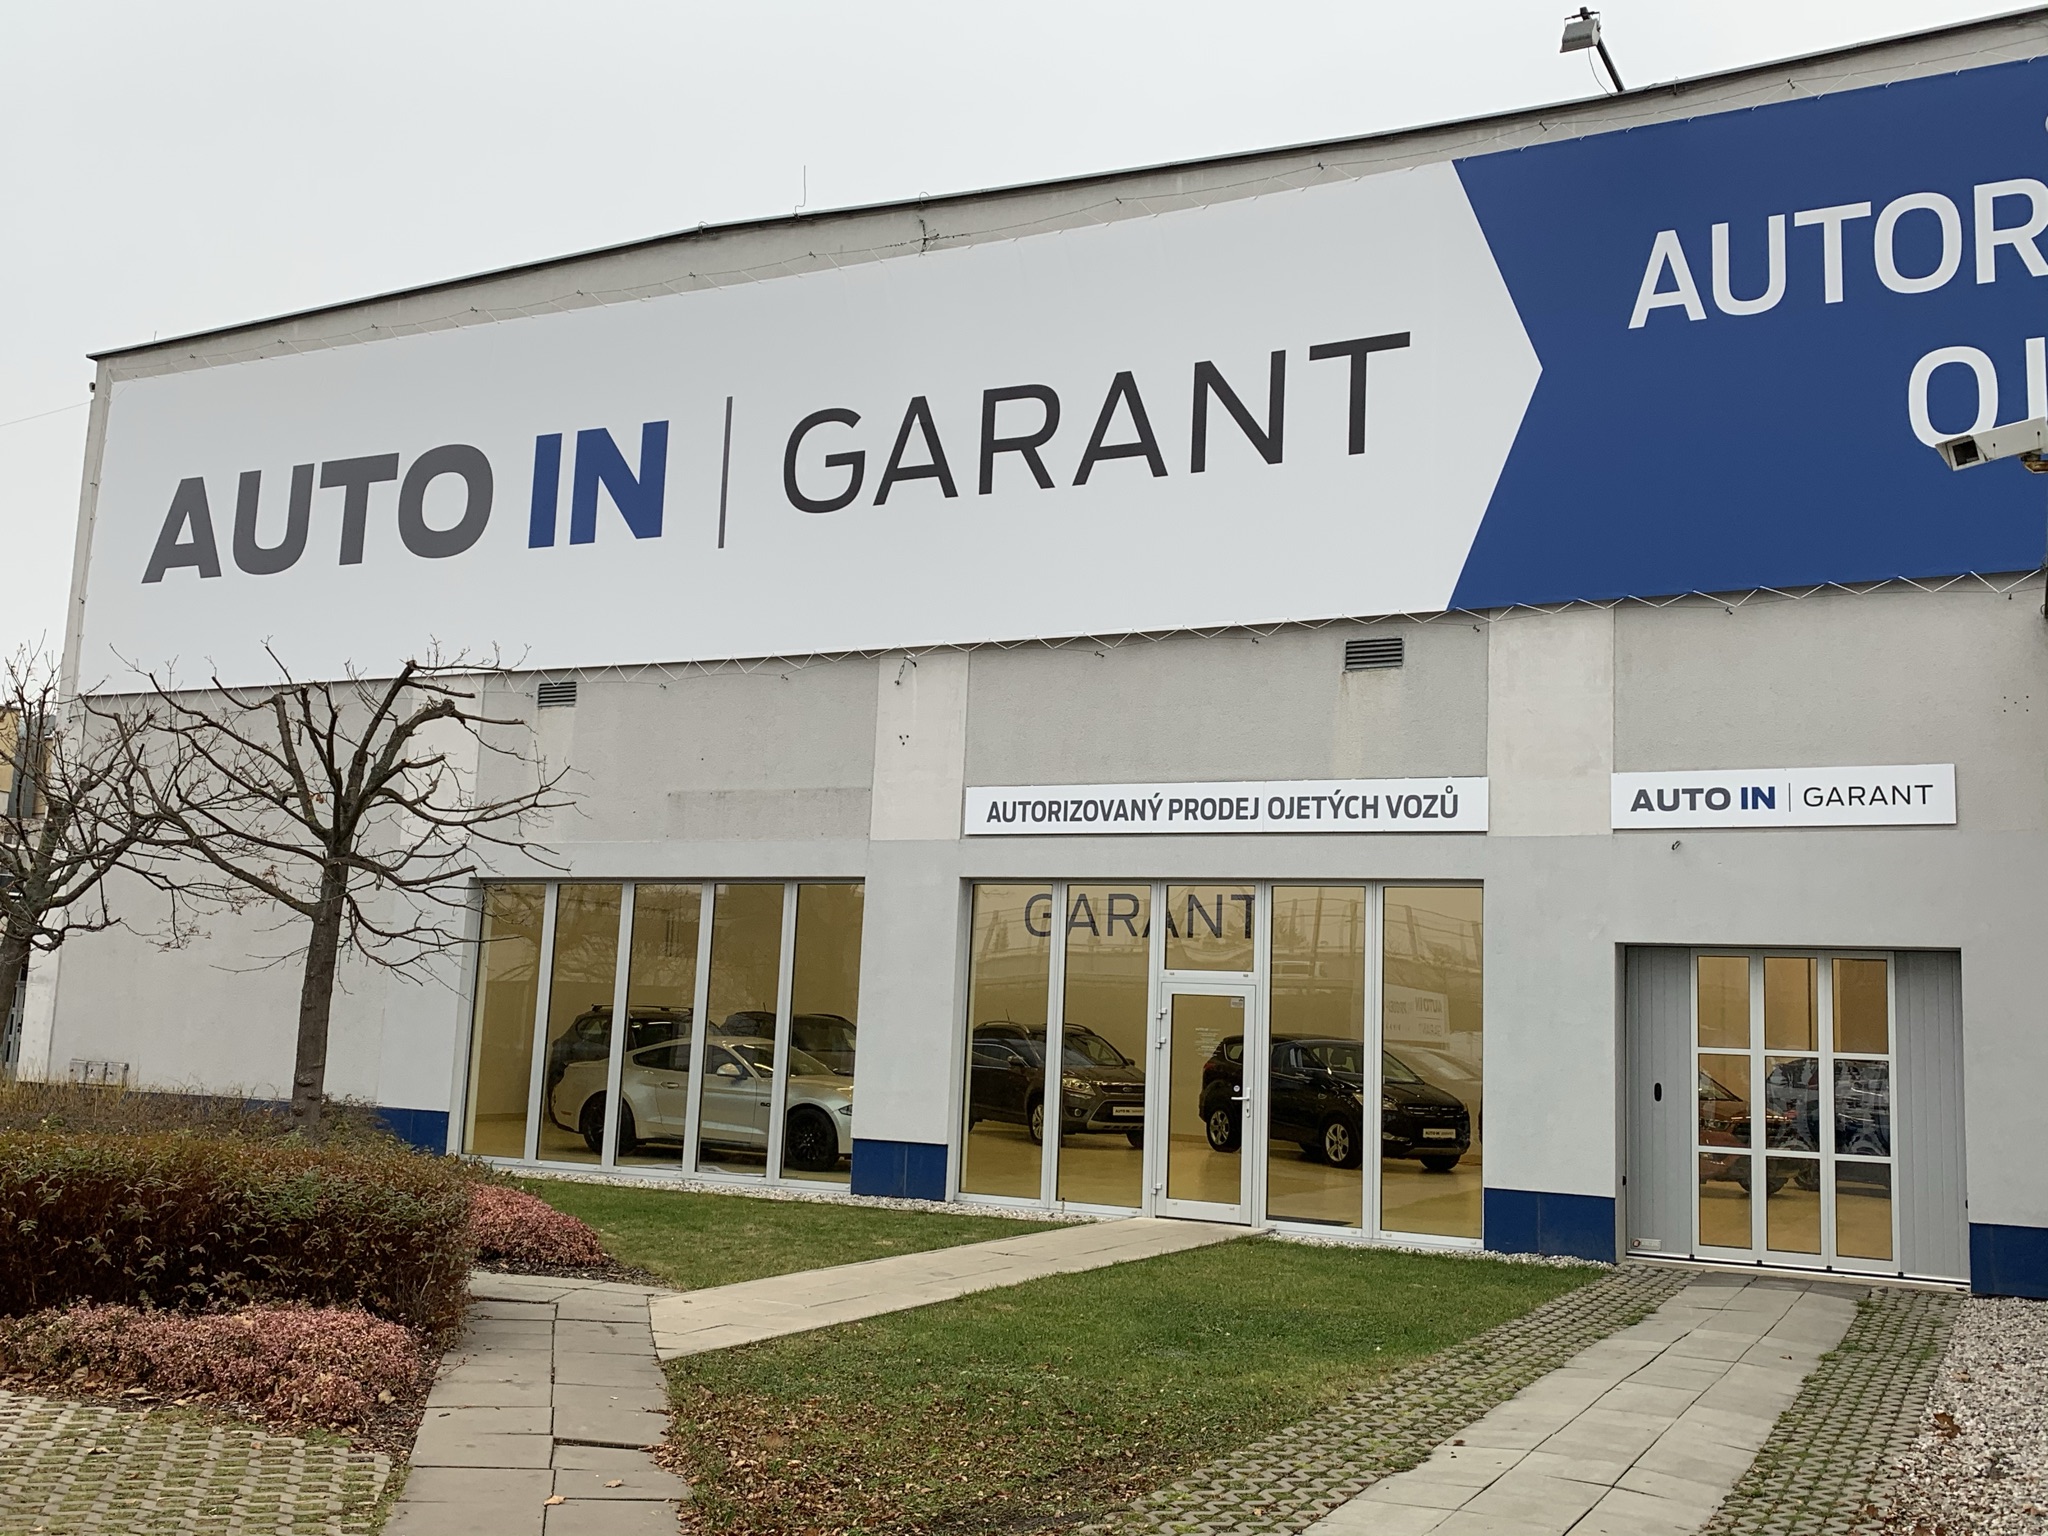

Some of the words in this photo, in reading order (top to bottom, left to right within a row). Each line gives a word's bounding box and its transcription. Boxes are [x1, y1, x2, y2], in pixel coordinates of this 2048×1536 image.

[141, 444, 494, 584] AUTO
[528, 420, 669, 549] IN
[783, 331, 1411, 514] GARANT
[987, 792, 1163, 823] AUTORIZOVANÝ
[1168, 797, 1259, 821] PRODEJ
[1267, 789, 1379, 820] OJETÝCH
[1385, 785, 1459, 819] VOZŮ
[1630, 787, 1731, 812] AUTO
[1740, 786, 1776, 810] IN
[1803, 784, 1934, 807] GARANT
